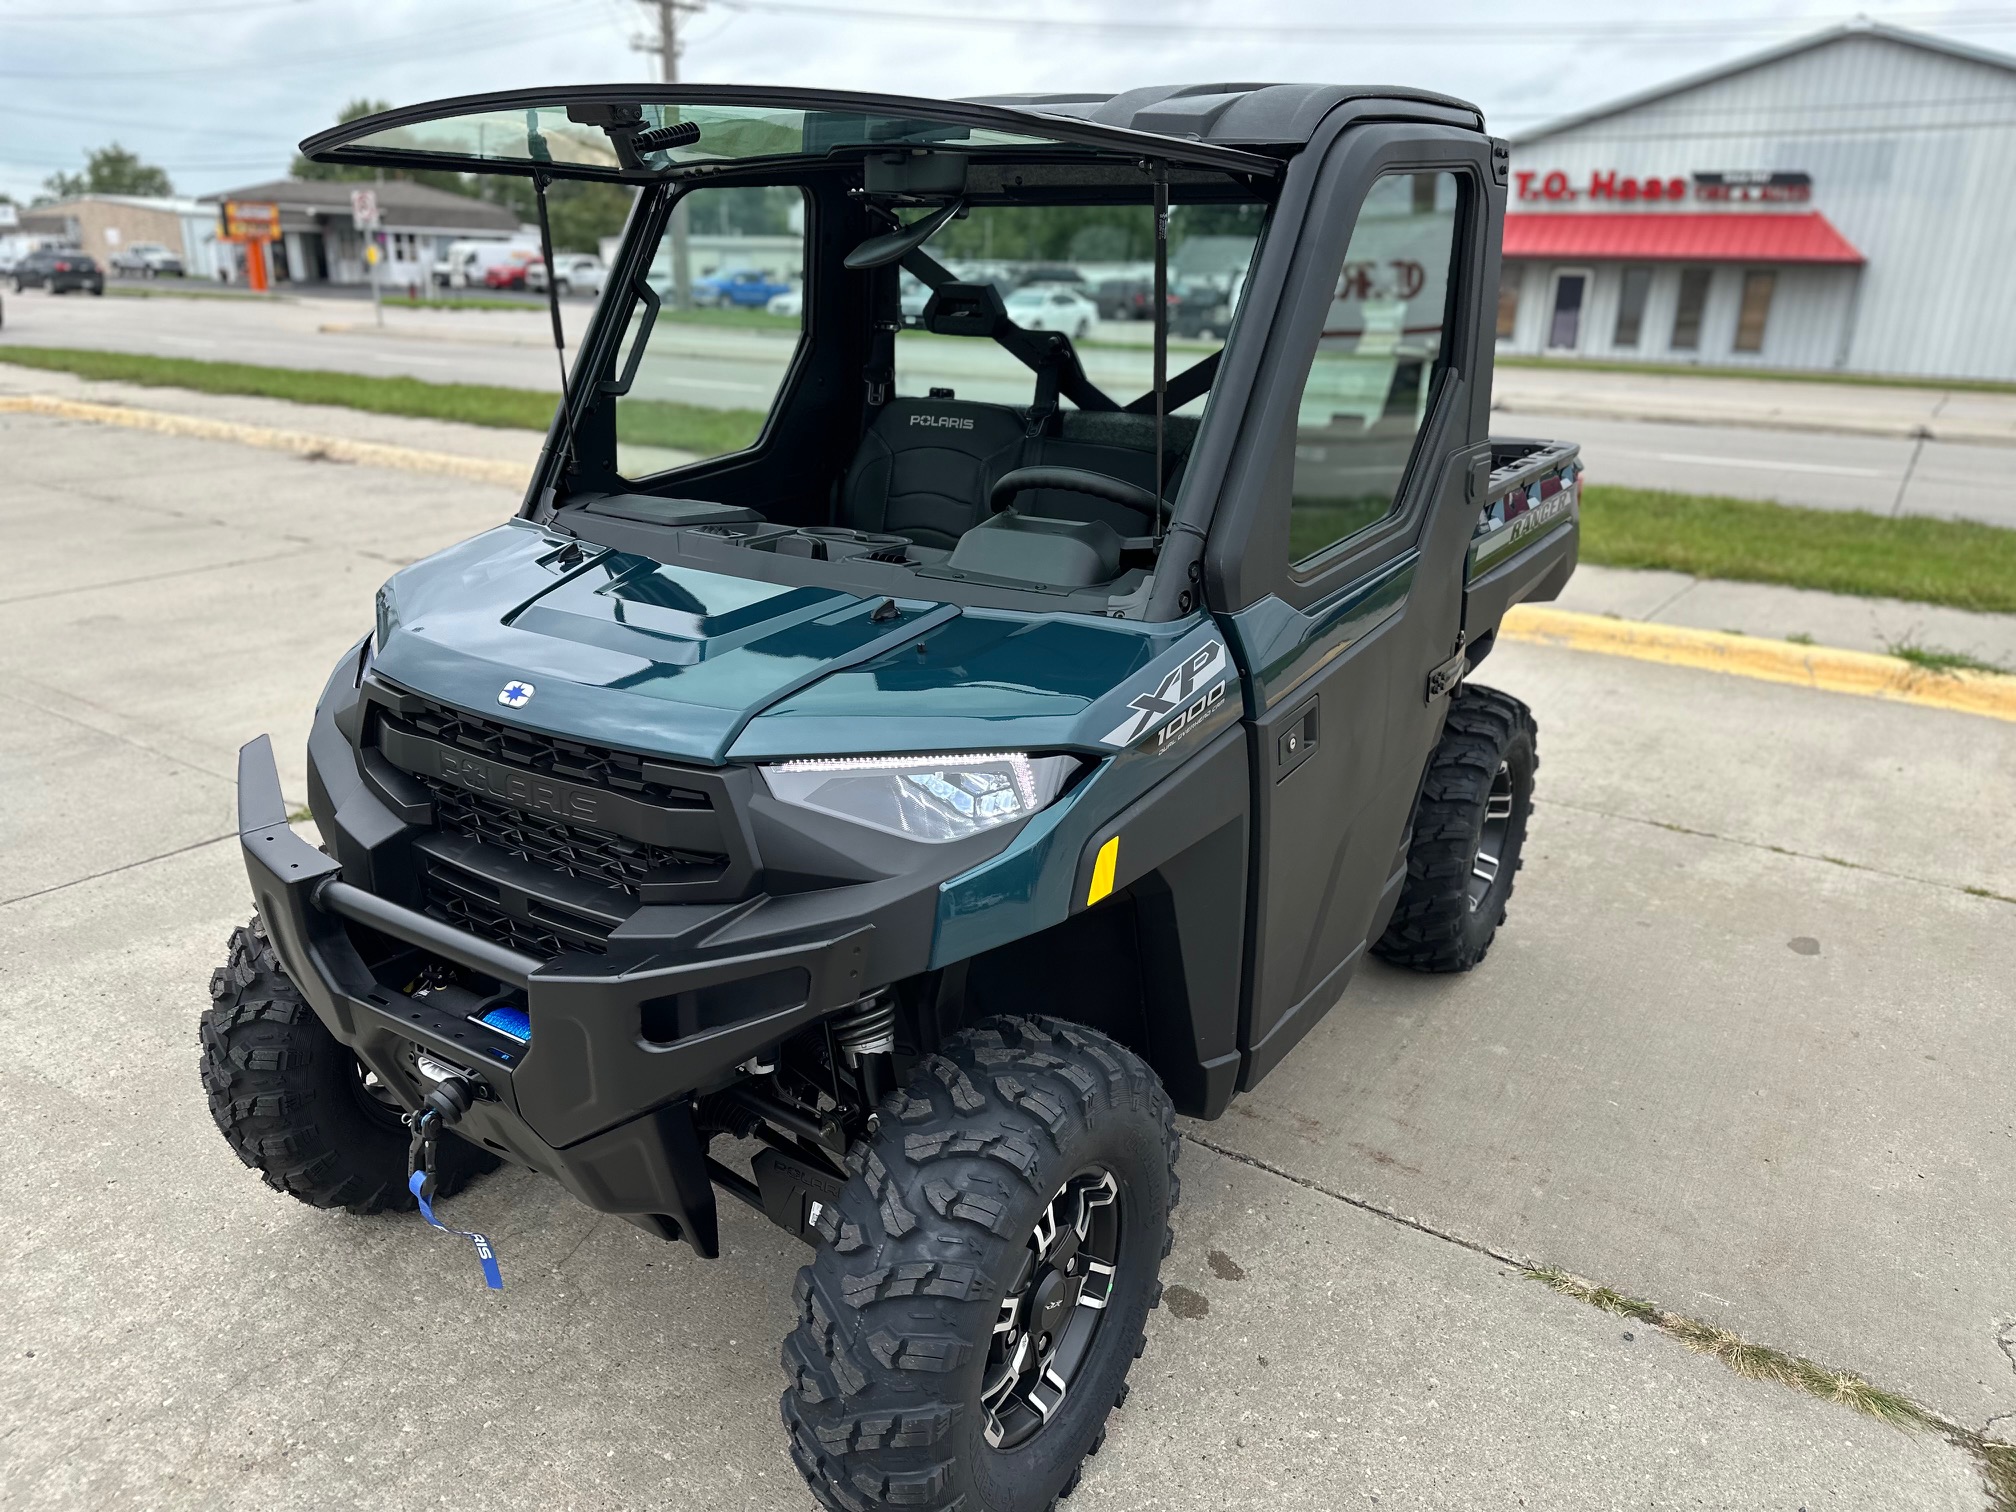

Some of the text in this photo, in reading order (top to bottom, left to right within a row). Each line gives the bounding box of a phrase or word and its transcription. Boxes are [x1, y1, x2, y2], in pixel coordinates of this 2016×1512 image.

[1514, 171, 1577, 201] T.O.
[1588, 169, 1687, 200] Haas
[909, 414, 975, 430] POLARIS
[1508, 490, 1569, 544] RANGER
[1118, 638, 1225, 747] XP
[1157, 679, 1226, 747] 1000
[439, 749, 599, 824] POLARIS
[773, 1160, 842, 1198] POLARI
